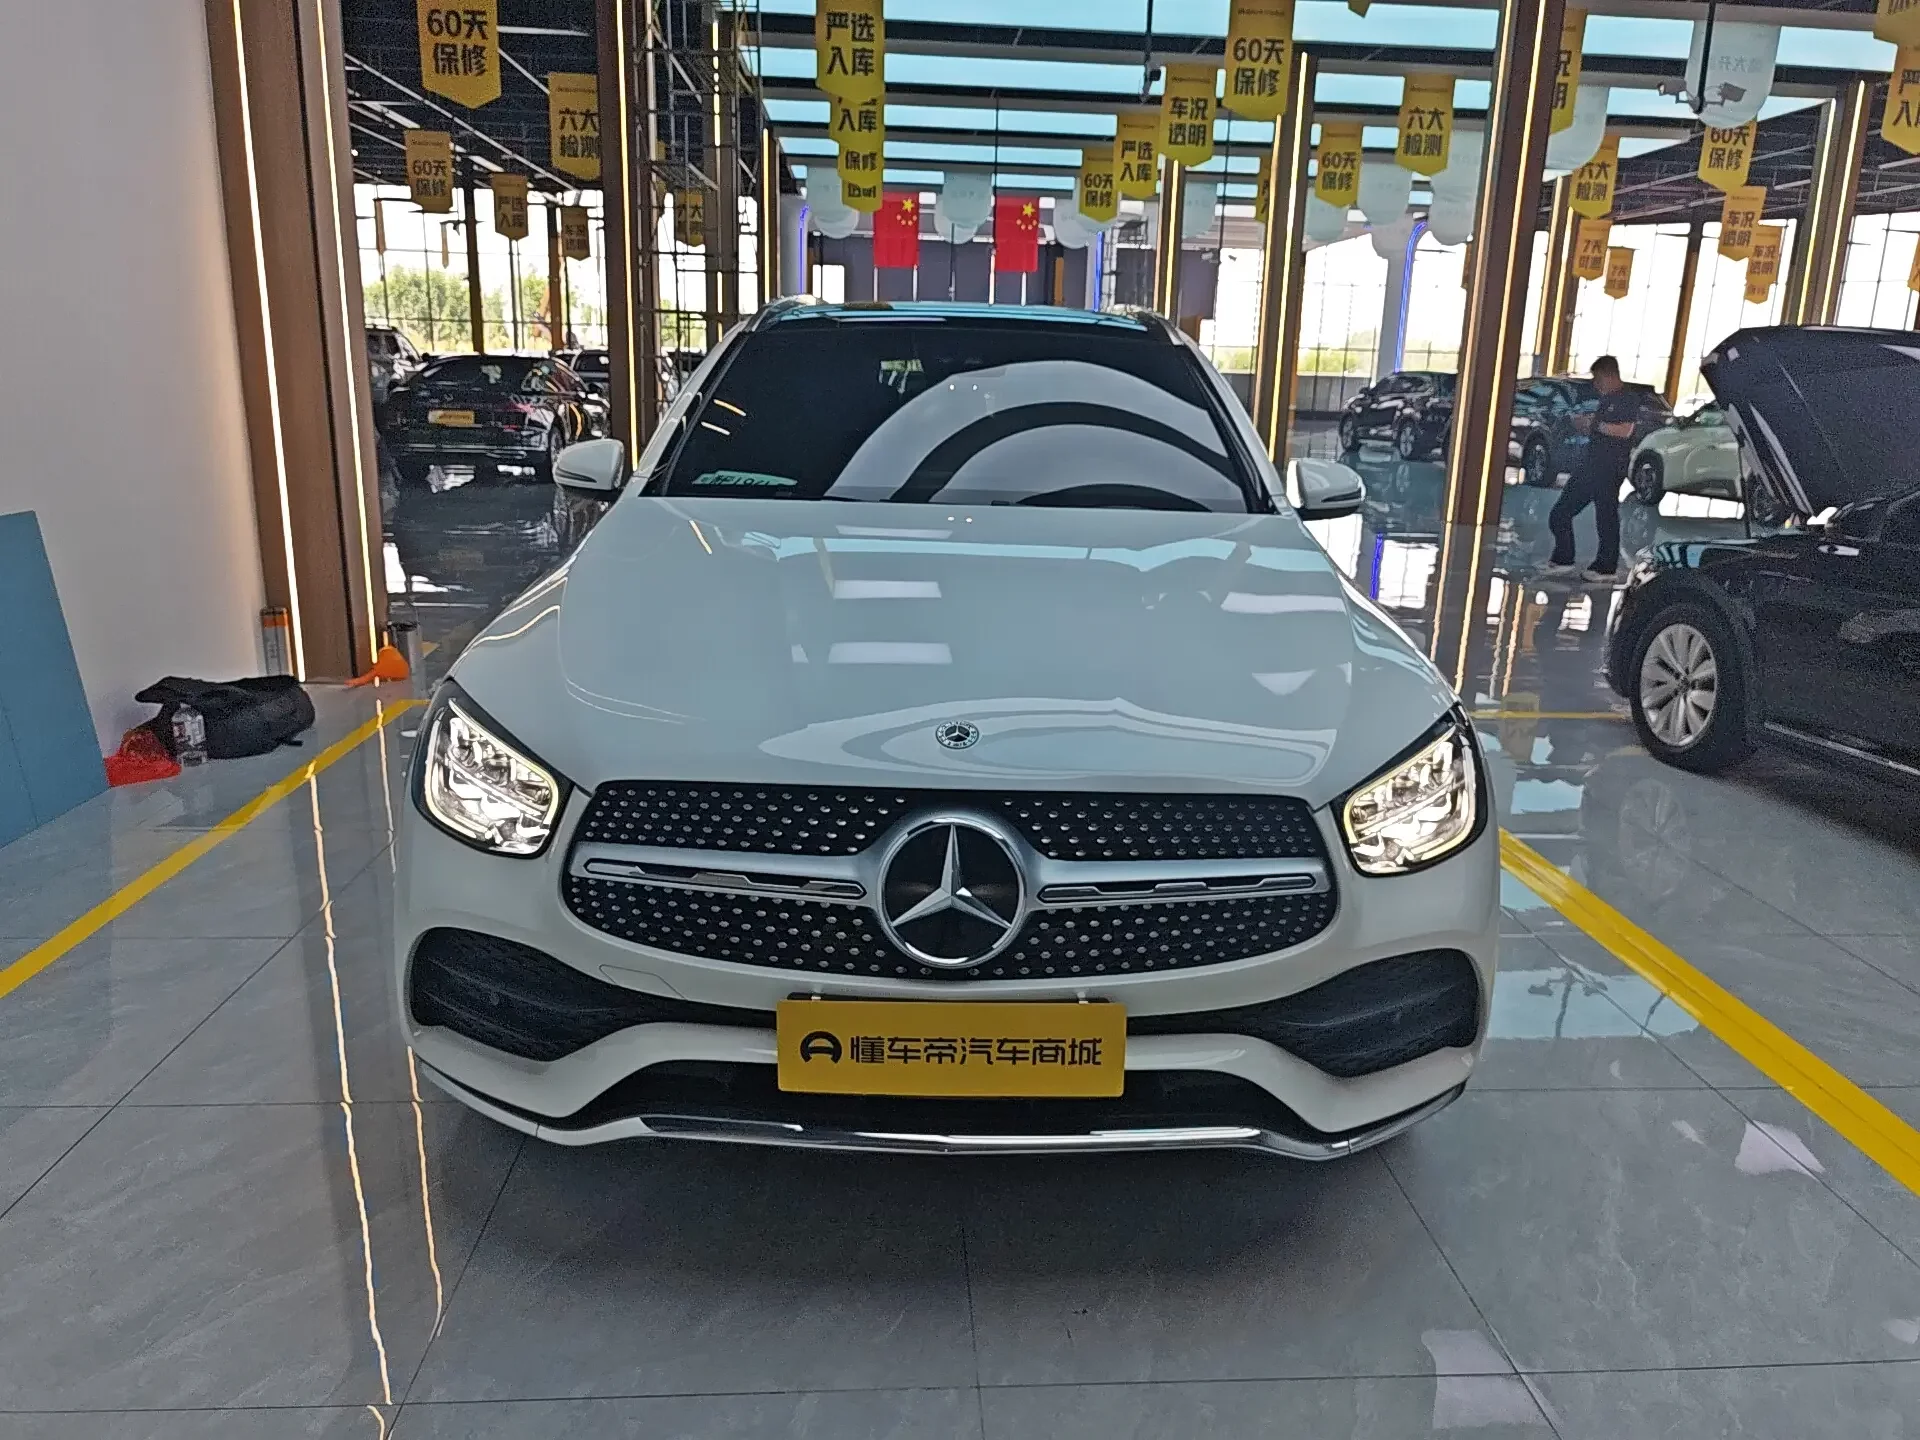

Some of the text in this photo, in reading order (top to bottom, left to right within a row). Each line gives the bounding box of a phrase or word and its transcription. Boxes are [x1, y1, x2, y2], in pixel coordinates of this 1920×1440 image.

[427, 9, 489, 40] 60天
[826, 12, 875, 43] 严选
[433, 43, 487, 77] 保修
[826, 46, 875, 76] 入库
[1233, 37, 1285, 65] 60天
[1234, 67, 1281, 97] 保修
[559, 108, 600, 132] 六大
[1169, 97, 1209, 120] 车况
[1407, 106, 1446, 131] 六大
[1892, 100, 1920, 127] 入
[838, 109, 877, 133] 入库
[1168, 123, 1207, 147] 透明
[1403, 134, 1443, 157] 检测
[1121, 140, 1153, 161] 严选
[1321, 152, 1357, 170] 60天
[1707, 147, 1743, 170] 保修
[413, 160, 447, 176] 60天
[1120, 162, 1152, 183] 入库
[1084, 172, 1113, 189] 60天
[1322, 172, 1352, 191] 保修
[850, 1035, 1102, 1067] 懂车帝汽车商城
